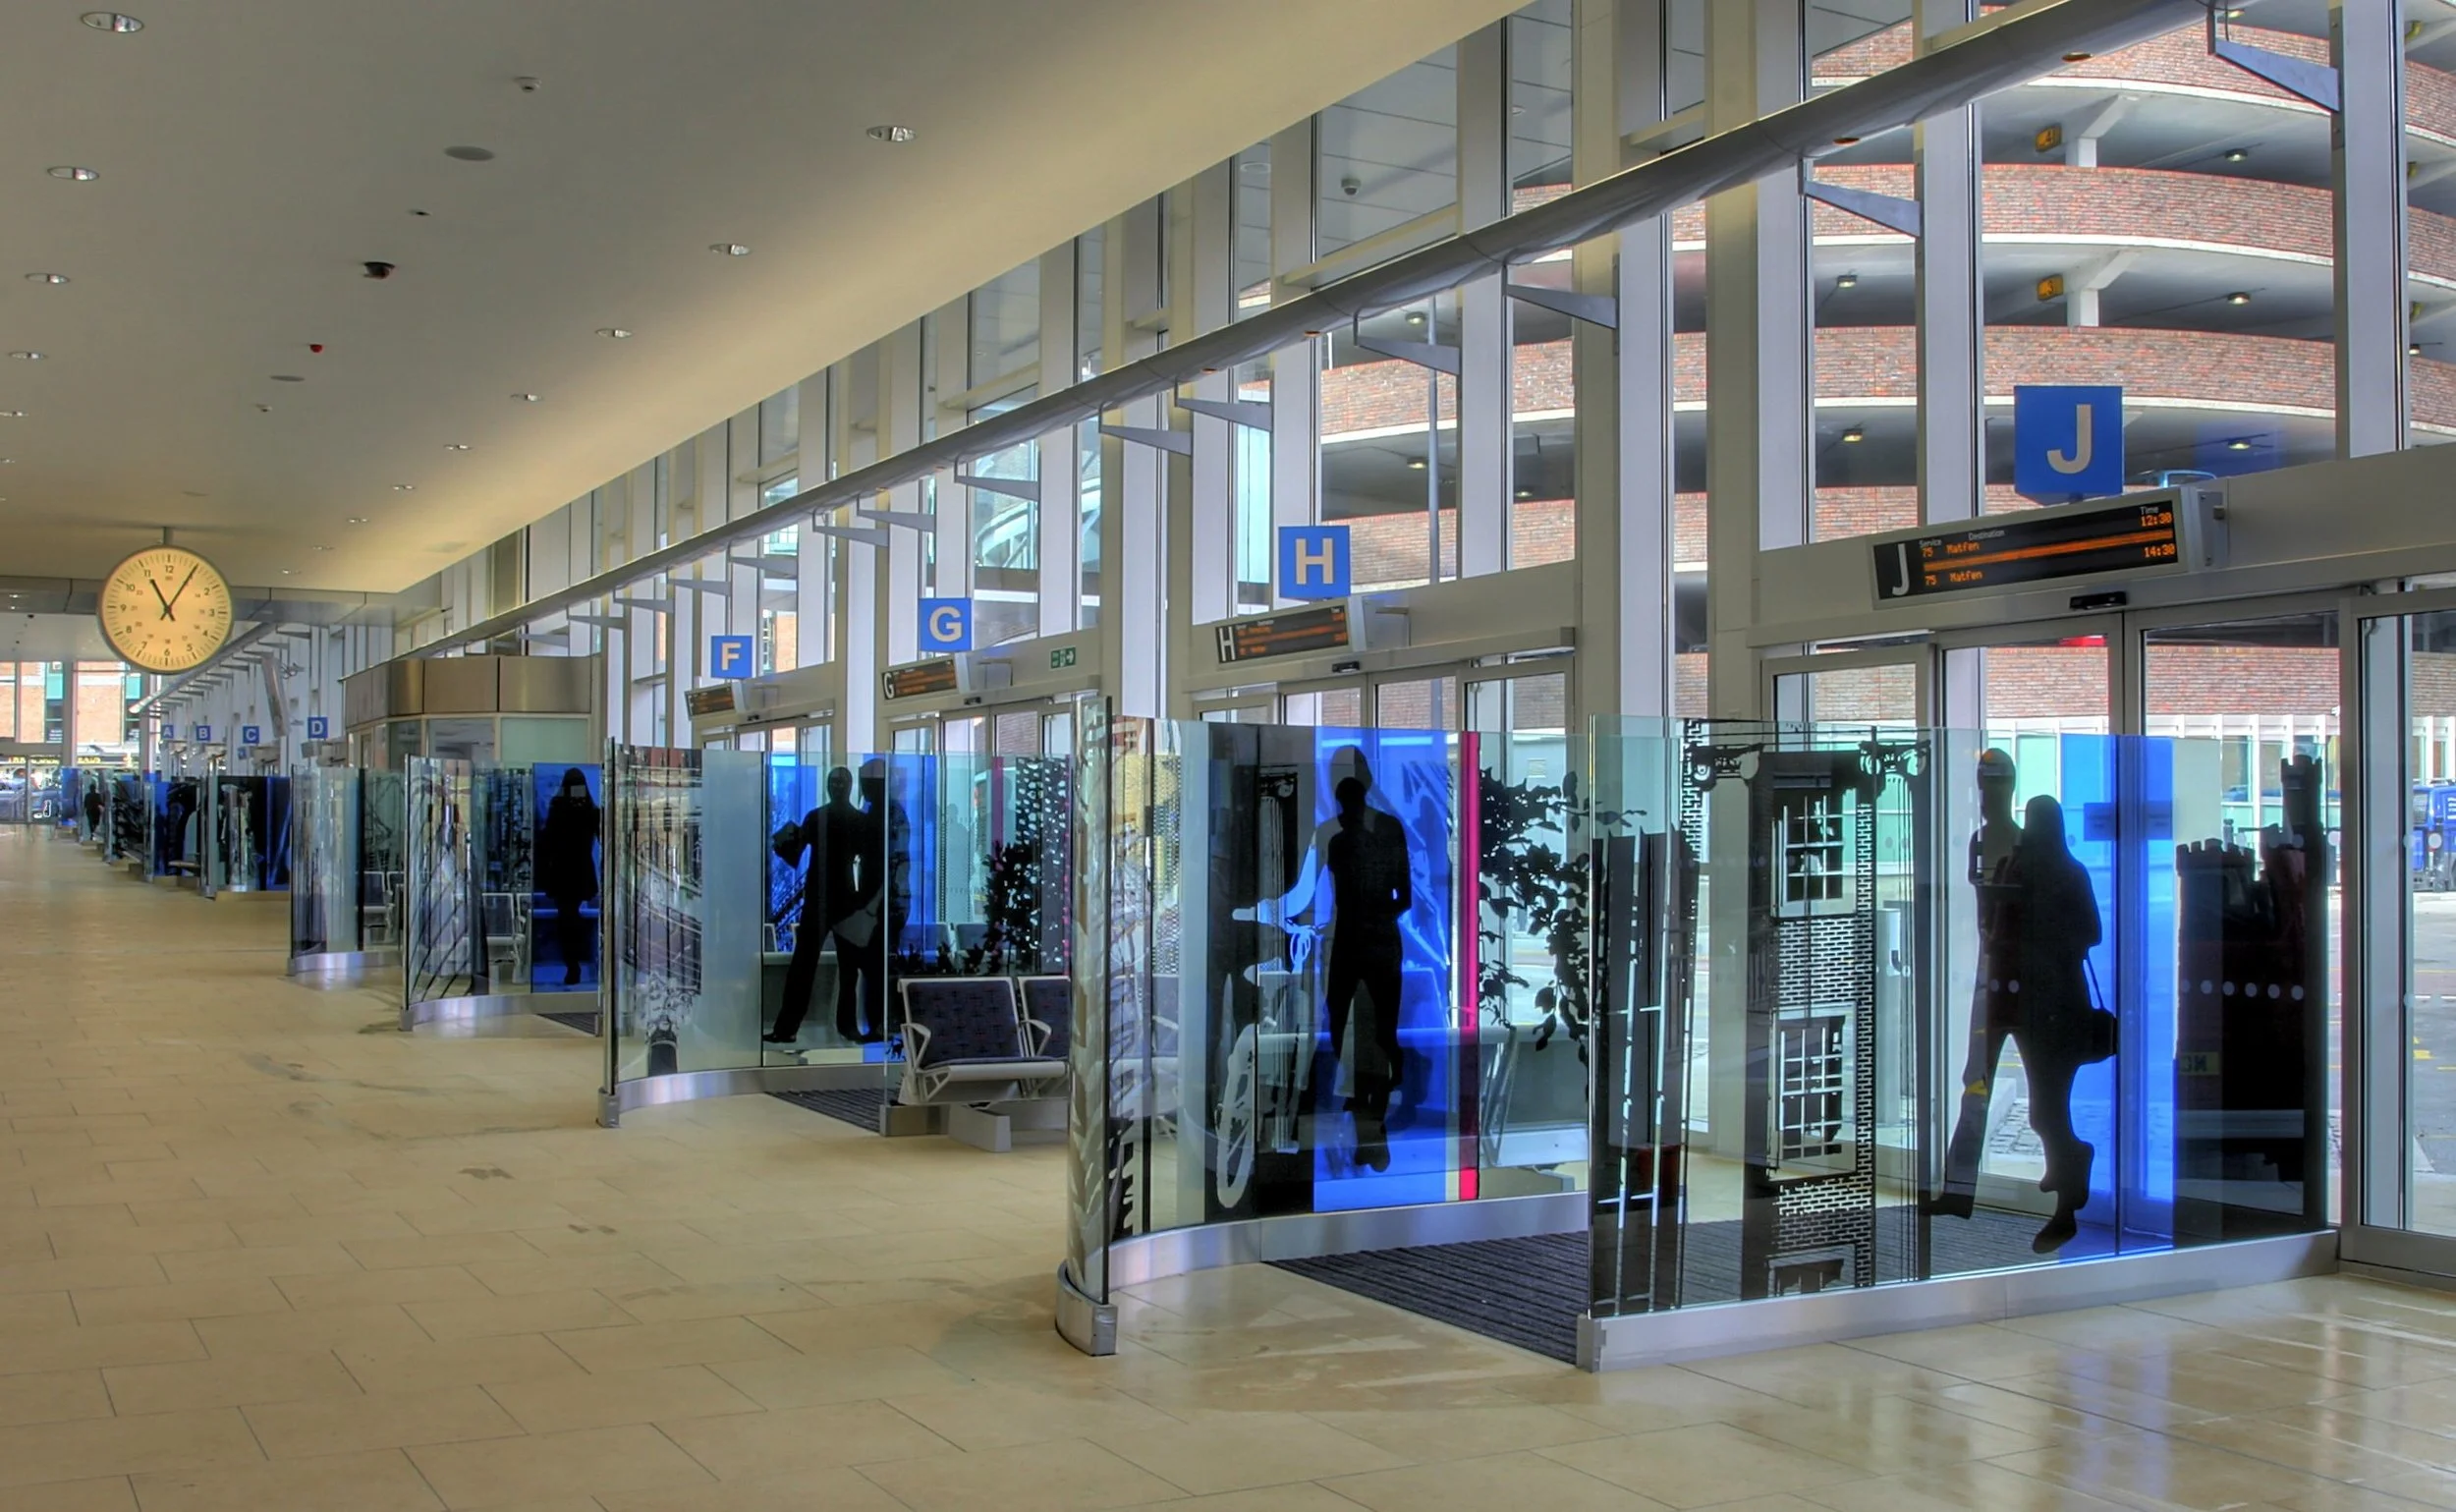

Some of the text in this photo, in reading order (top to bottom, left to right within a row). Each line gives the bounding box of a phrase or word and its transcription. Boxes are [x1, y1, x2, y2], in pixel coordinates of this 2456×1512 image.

[2046, 404, 2093, 475] J
[2140, 506, 2159, 515] Time
[2141, 512, 2172, 528] 12:30
[2144, 543, 2176, 558] 14:30
[1295, 537, 1334, 585] H
[164, 565, 175, 574] 12
[1892, 543, 1910, 596] J
[126, 584, 136, 592] 10
[203, 588, 210, 596] 2
[208, 608, 215, 617] 3
[928, 606, 963, 643] G
[187, 644, 193, 652] 5
[1219, 626, 1237, 662] H
[720, 642, 741, 671] F
[883, 672, 895, 700] G
[163, 725, 172, 736] A
[198, 728, 208, 739] B
[246, 728, 257, 741] C
[310, 720, 323, 735] D
